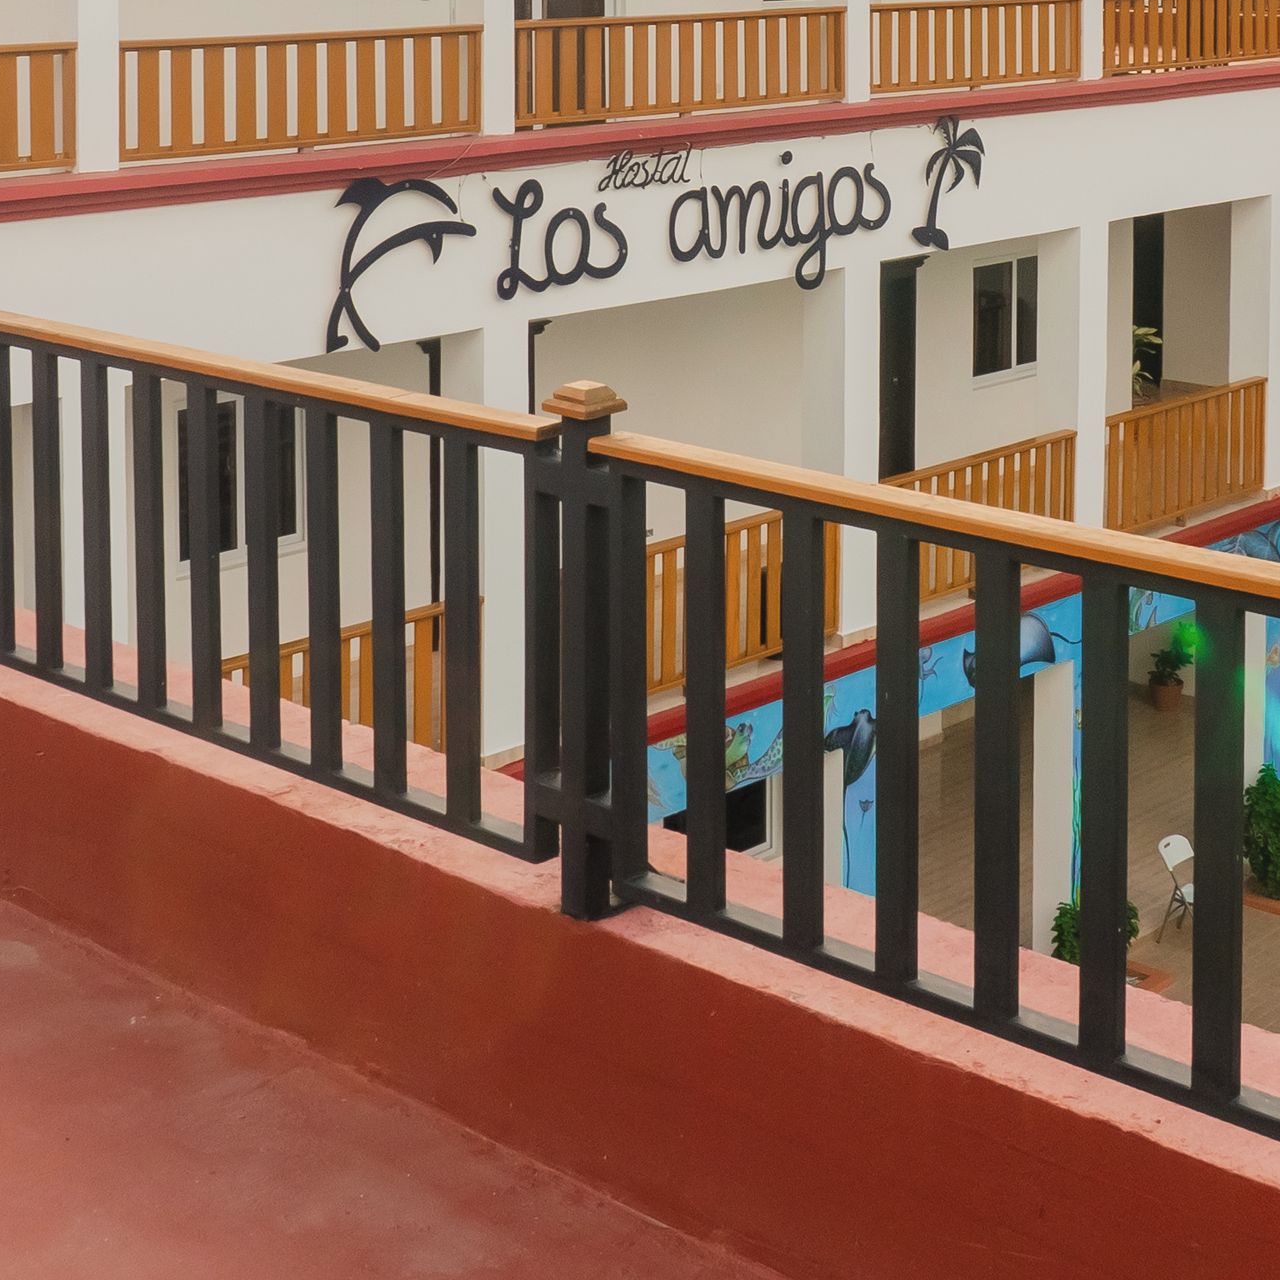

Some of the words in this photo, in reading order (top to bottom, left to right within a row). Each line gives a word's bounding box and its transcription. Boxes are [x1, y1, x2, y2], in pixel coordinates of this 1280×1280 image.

[597, 141, 693, 192] Hostal
[492, 179, 628, 301] Los
[668, 150, 892, 291] amigos
